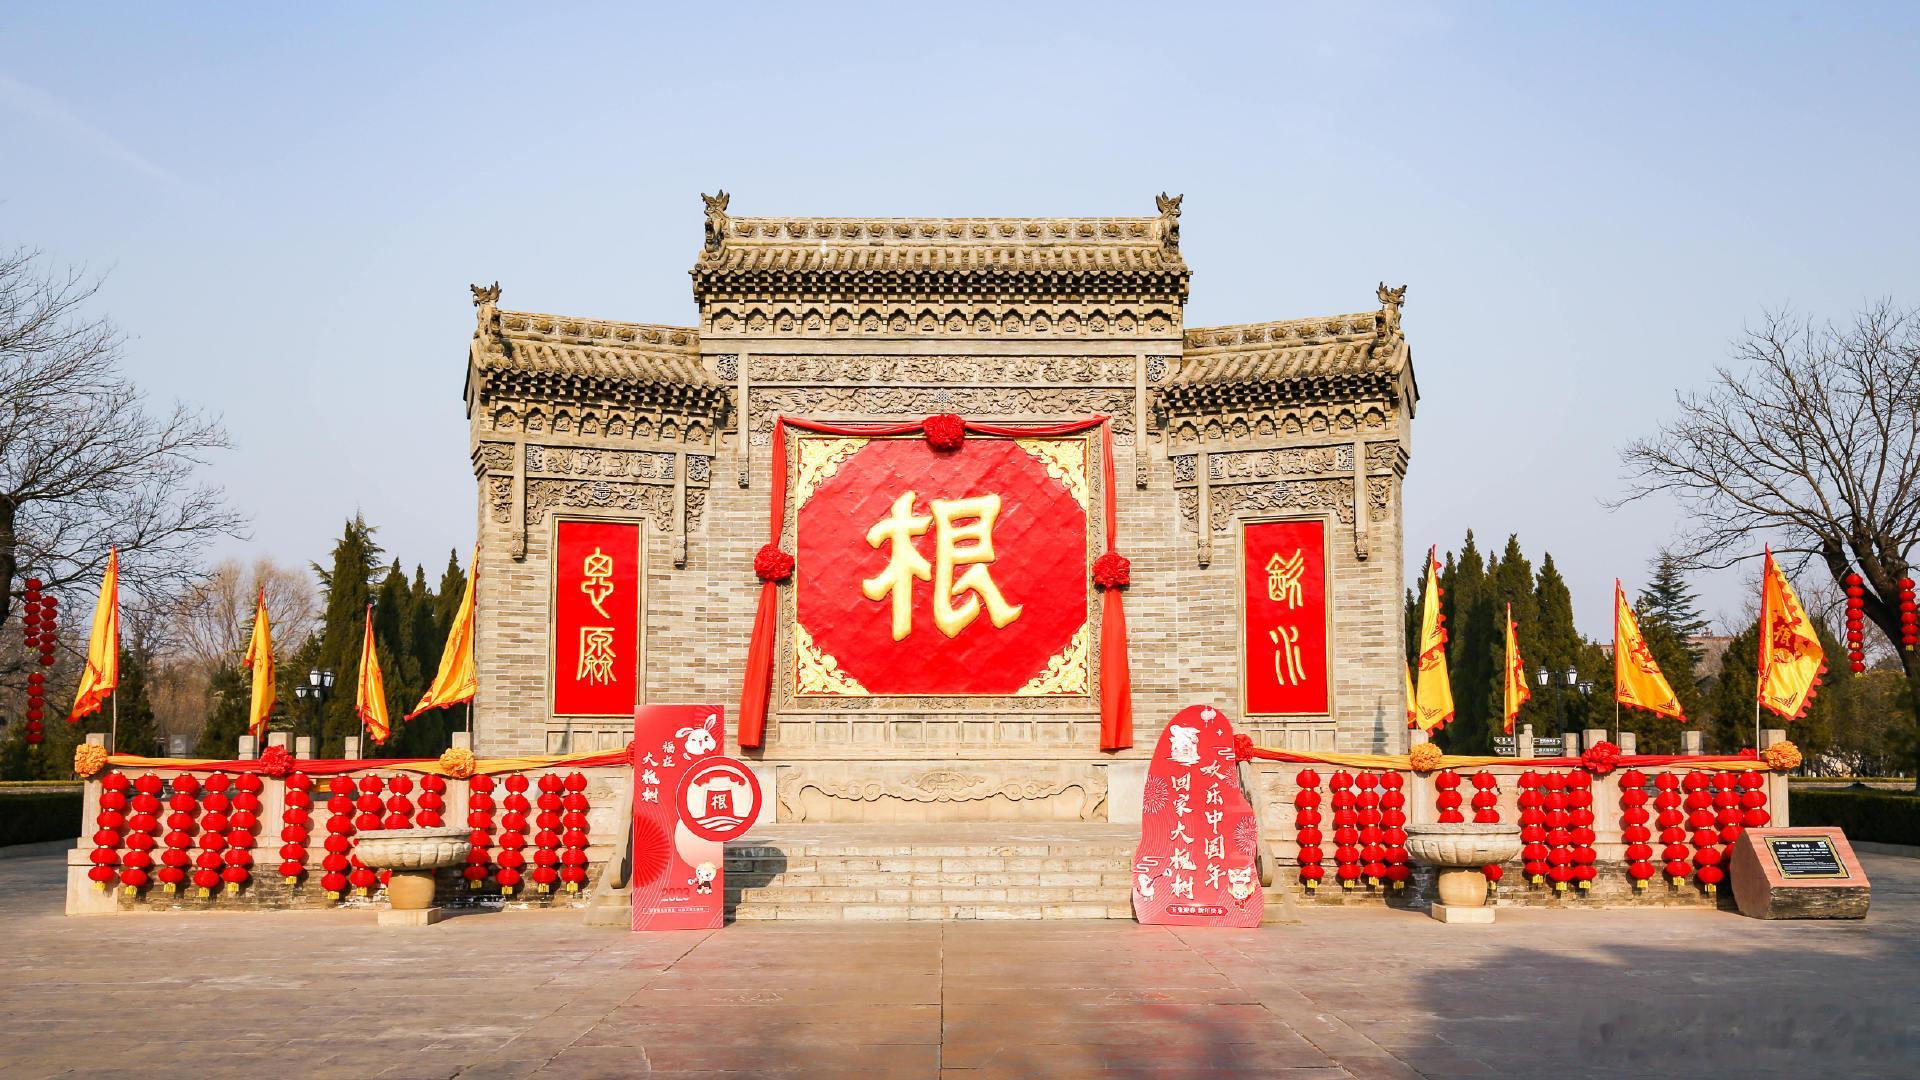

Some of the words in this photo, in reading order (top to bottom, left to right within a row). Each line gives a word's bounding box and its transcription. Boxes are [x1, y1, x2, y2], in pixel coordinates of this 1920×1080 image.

[862, 491, 1024, 641] 根
[641, 751, 660, 804] 大槐树
[662, 740, 676, 768] 福在
[710, 793, 728, 810] 根
[1170, 773, 1197, 900] 回家大槐树
[1200, 760, 1227, 889] 欢乐中国年
